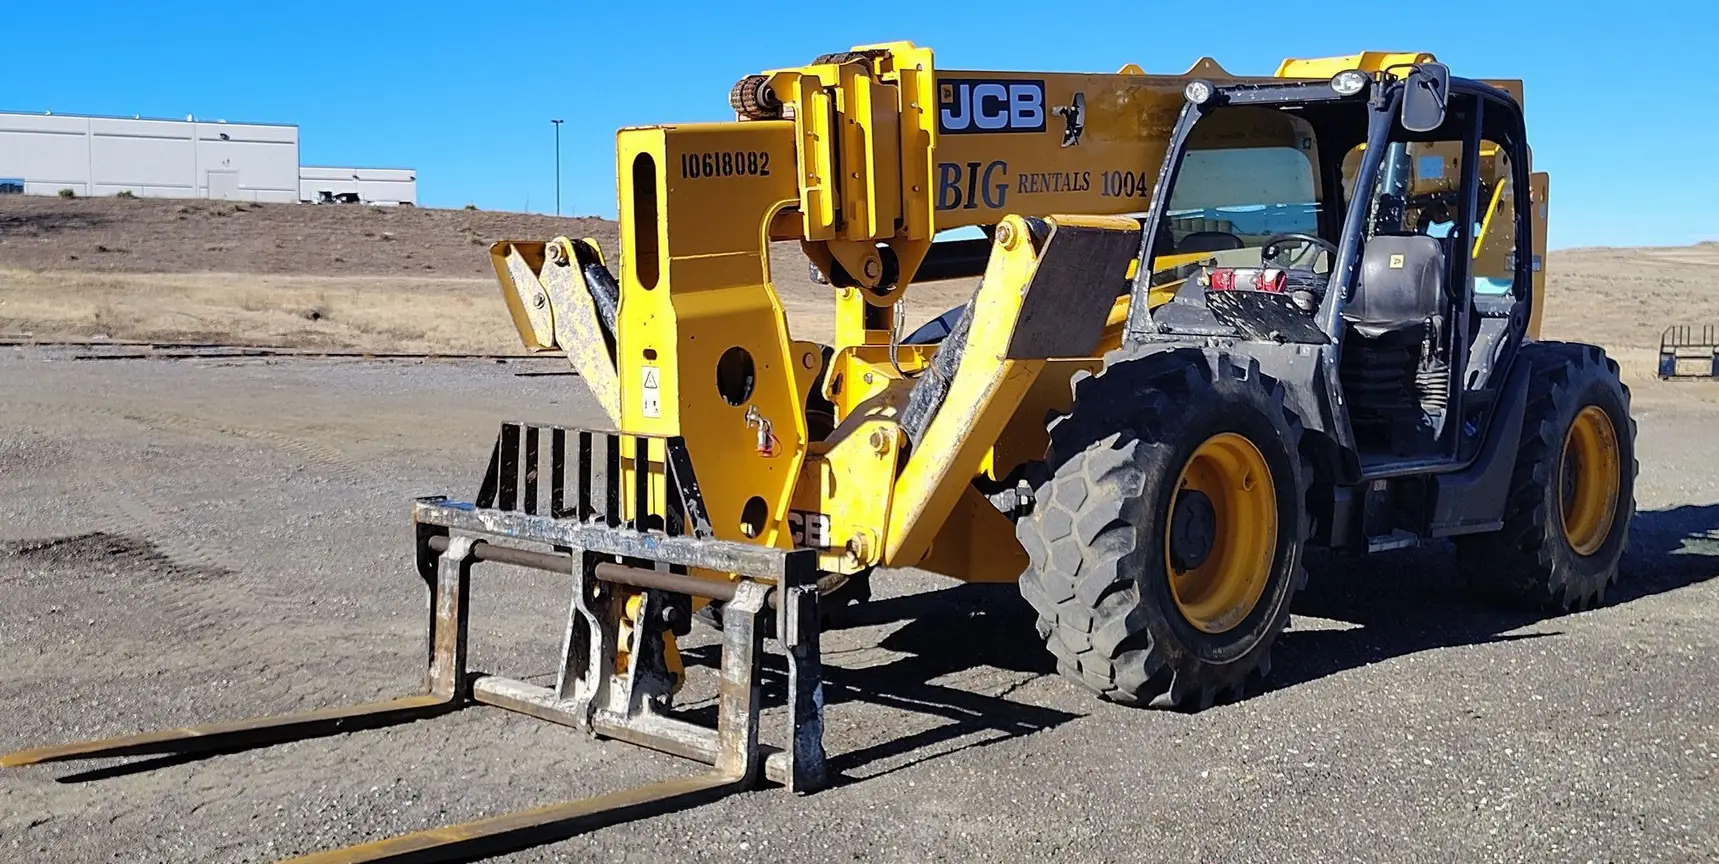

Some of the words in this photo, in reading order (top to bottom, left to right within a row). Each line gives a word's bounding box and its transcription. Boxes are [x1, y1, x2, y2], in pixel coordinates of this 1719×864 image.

[941, 84, 1043, 129] JCB
[681, 151, 770, 179] 10618082
[935, 160, 1009, 211] BIG
[1017, 171, 1091, 194] RENTALS
[1100, 171, 1148, 198] 1004
